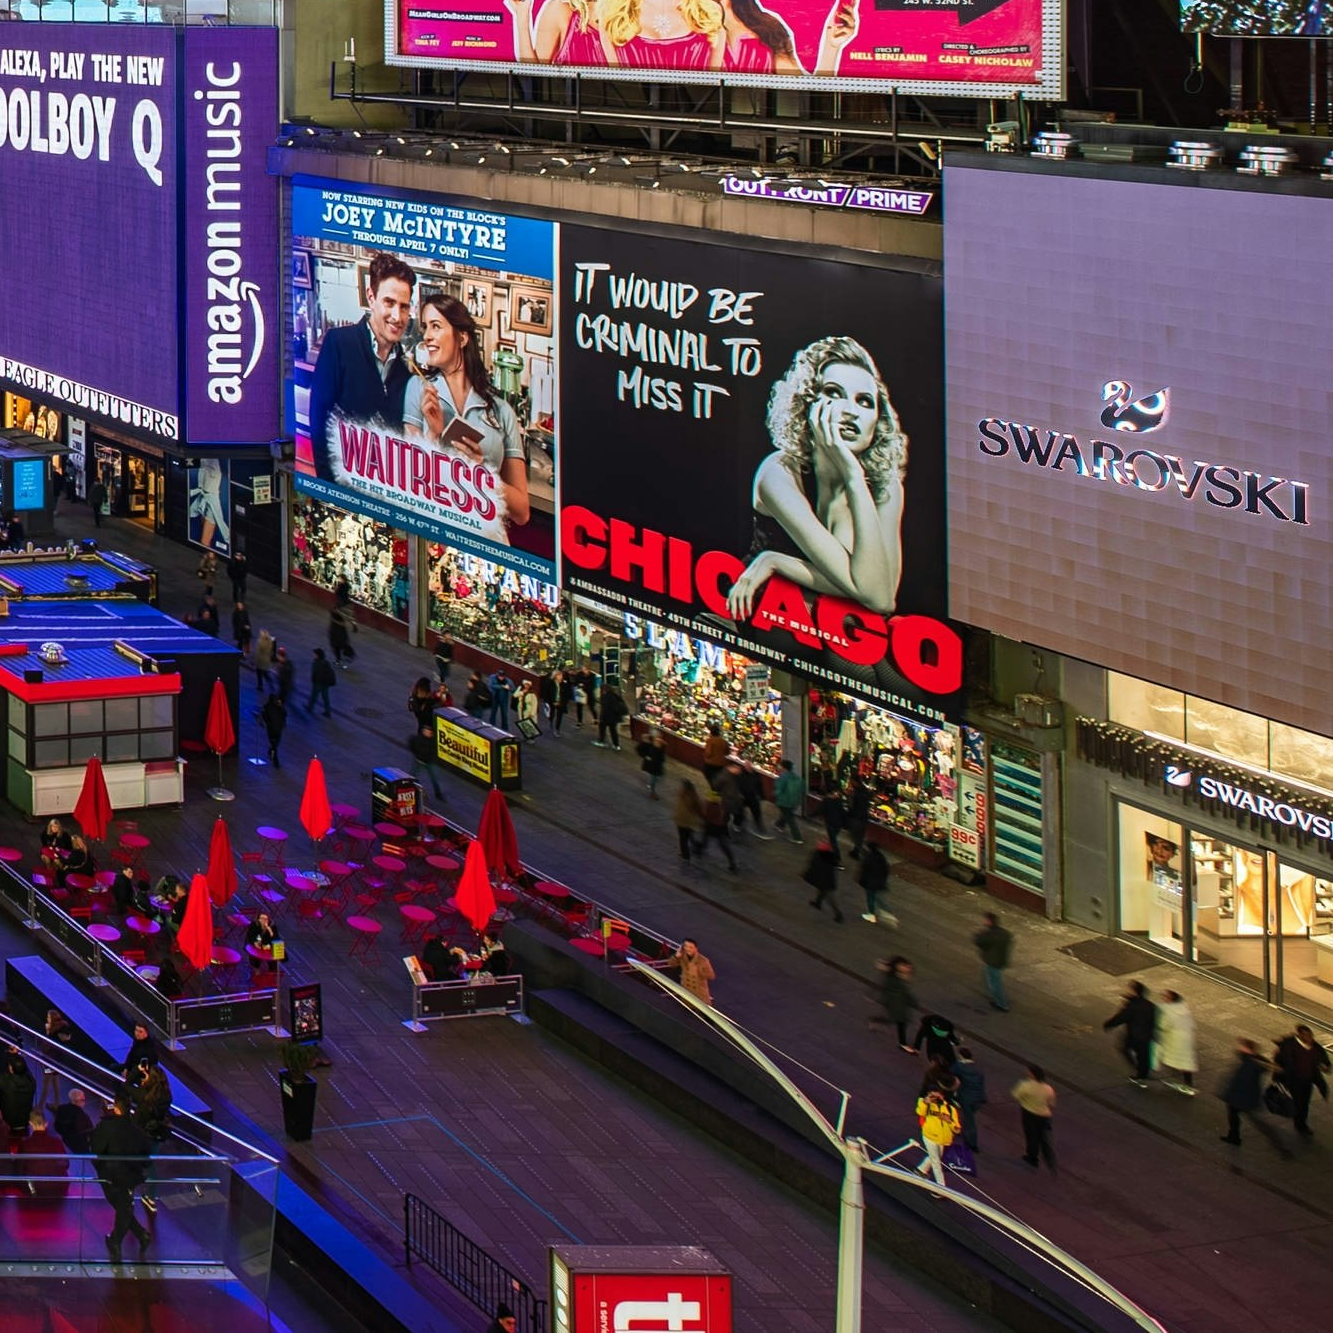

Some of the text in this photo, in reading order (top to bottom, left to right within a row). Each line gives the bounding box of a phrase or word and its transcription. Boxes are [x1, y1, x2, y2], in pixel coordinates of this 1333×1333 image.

[50, 52, 164, 86] PLAY THE NEW
[875, 53, 927, 63] BENJAMIN
[974, 57, 1033, 67] NICHOLAW
[132, 98, 163, 187] Q
[194, 62, 243, 210] music
[322, 202, 506, 251] JOEY McINTYRE
[343, 193, 383, 208] STARRING
[856, 190, 923, 211] PRIME
[352, 230, 427, 253] THROUGH APRIL
[610, 269, 764, 326] WOULD BE
[574, 312, 722, 373] CRIMINAL
[338, 419, 497, 523] WAITRESS
[351, 477, 367, 490] THE
[978, 417, 1310, 526] SWAROVSKI
[303, 478, 551, 576] BROOKS ATKINSON THEATRE WAITRESSTHEMUSICAL.COM
[462, 552, 559, 608] GRAND
[561, 504, 963, 696] CHICAGO
[761, 609, 850, 648] THE MUSICAL
[668, 610, 946, 722] 49TH STREET CHICAGOTHEMUSICAL.COM
[1200, 777, 1333, 840] SWAROVS
